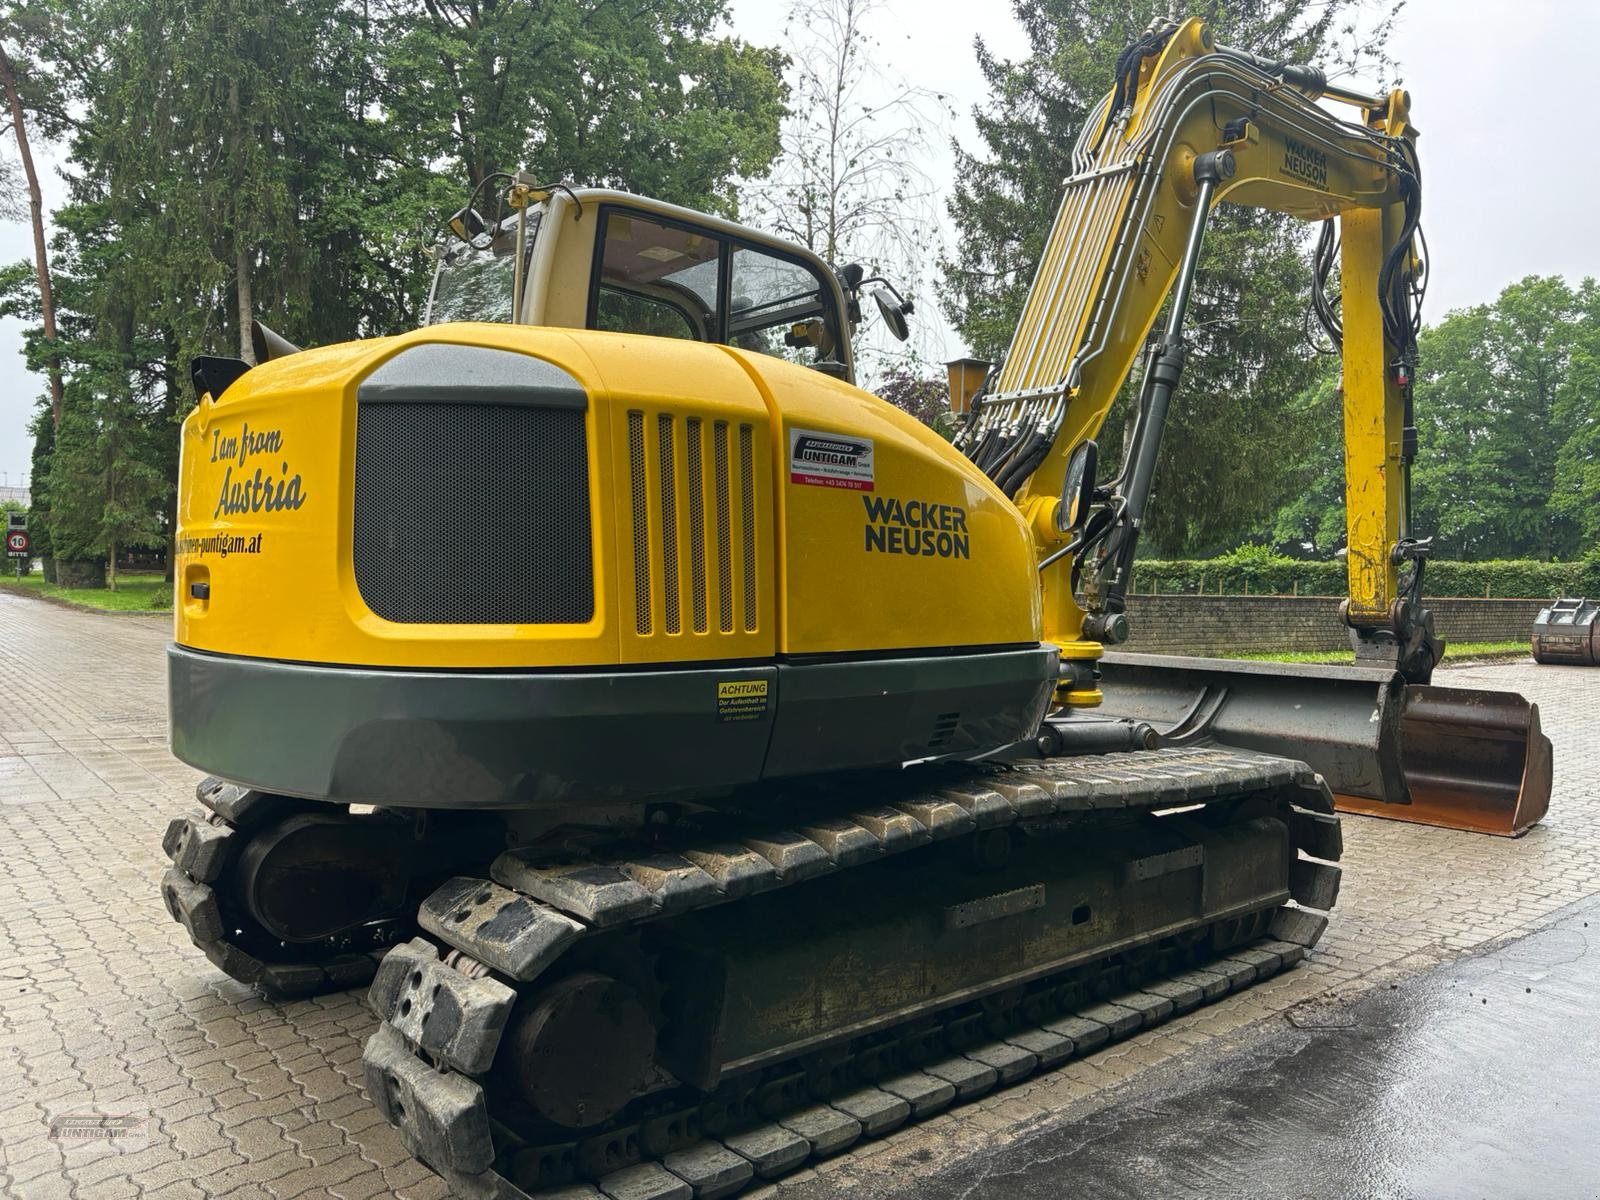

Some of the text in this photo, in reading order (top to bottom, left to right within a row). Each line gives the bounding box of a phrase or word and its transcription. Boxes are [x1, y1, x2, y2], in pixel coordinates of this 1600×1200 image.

[1285, 136, 1327, 169] WACKER
[1285, 153, 1327, 185] NEUSON
[210, 422, 284, 468] I am from
[214, 461, 306, 520] Austria
[862, 495, 968, 533] WACKER
[11, 537, 23, 546] 10
[865, 525, 970, 560] NEUSON
[721, 684, 766, 695] ACHTUNG
